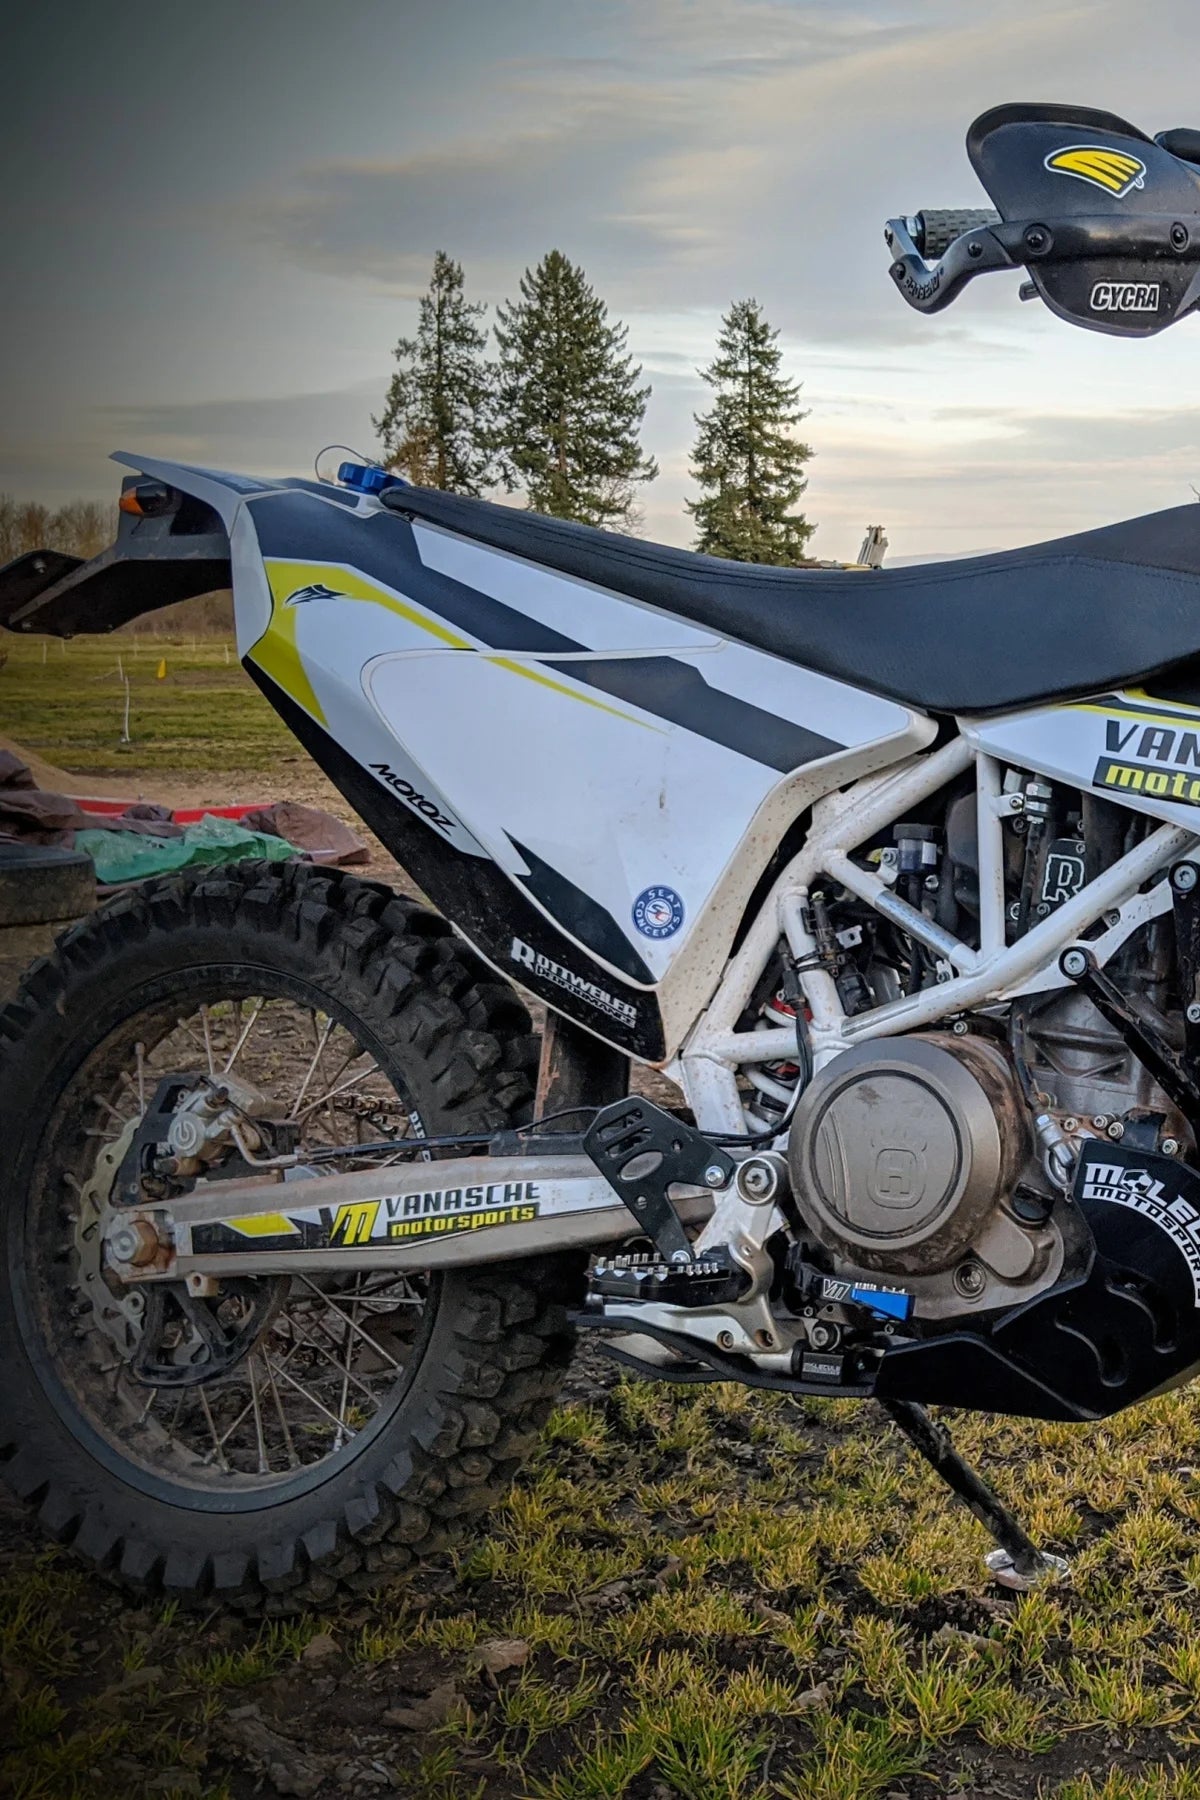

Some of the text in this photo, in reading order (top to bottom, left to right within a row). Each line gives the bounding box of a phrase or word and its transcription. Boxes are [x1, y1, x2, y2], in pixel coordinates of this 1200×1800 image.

[1091, 282, 1160, 311] CYCRA
[648, 889, 681, 908] SEAT
[635, 900, 680, 937] CONCEPTS
[511, 936, 637, 1019] ROTTWEILER
[386, 1182, 541, 1217] VANASCHE
[392, 1206, 535, 1238] motorsports
